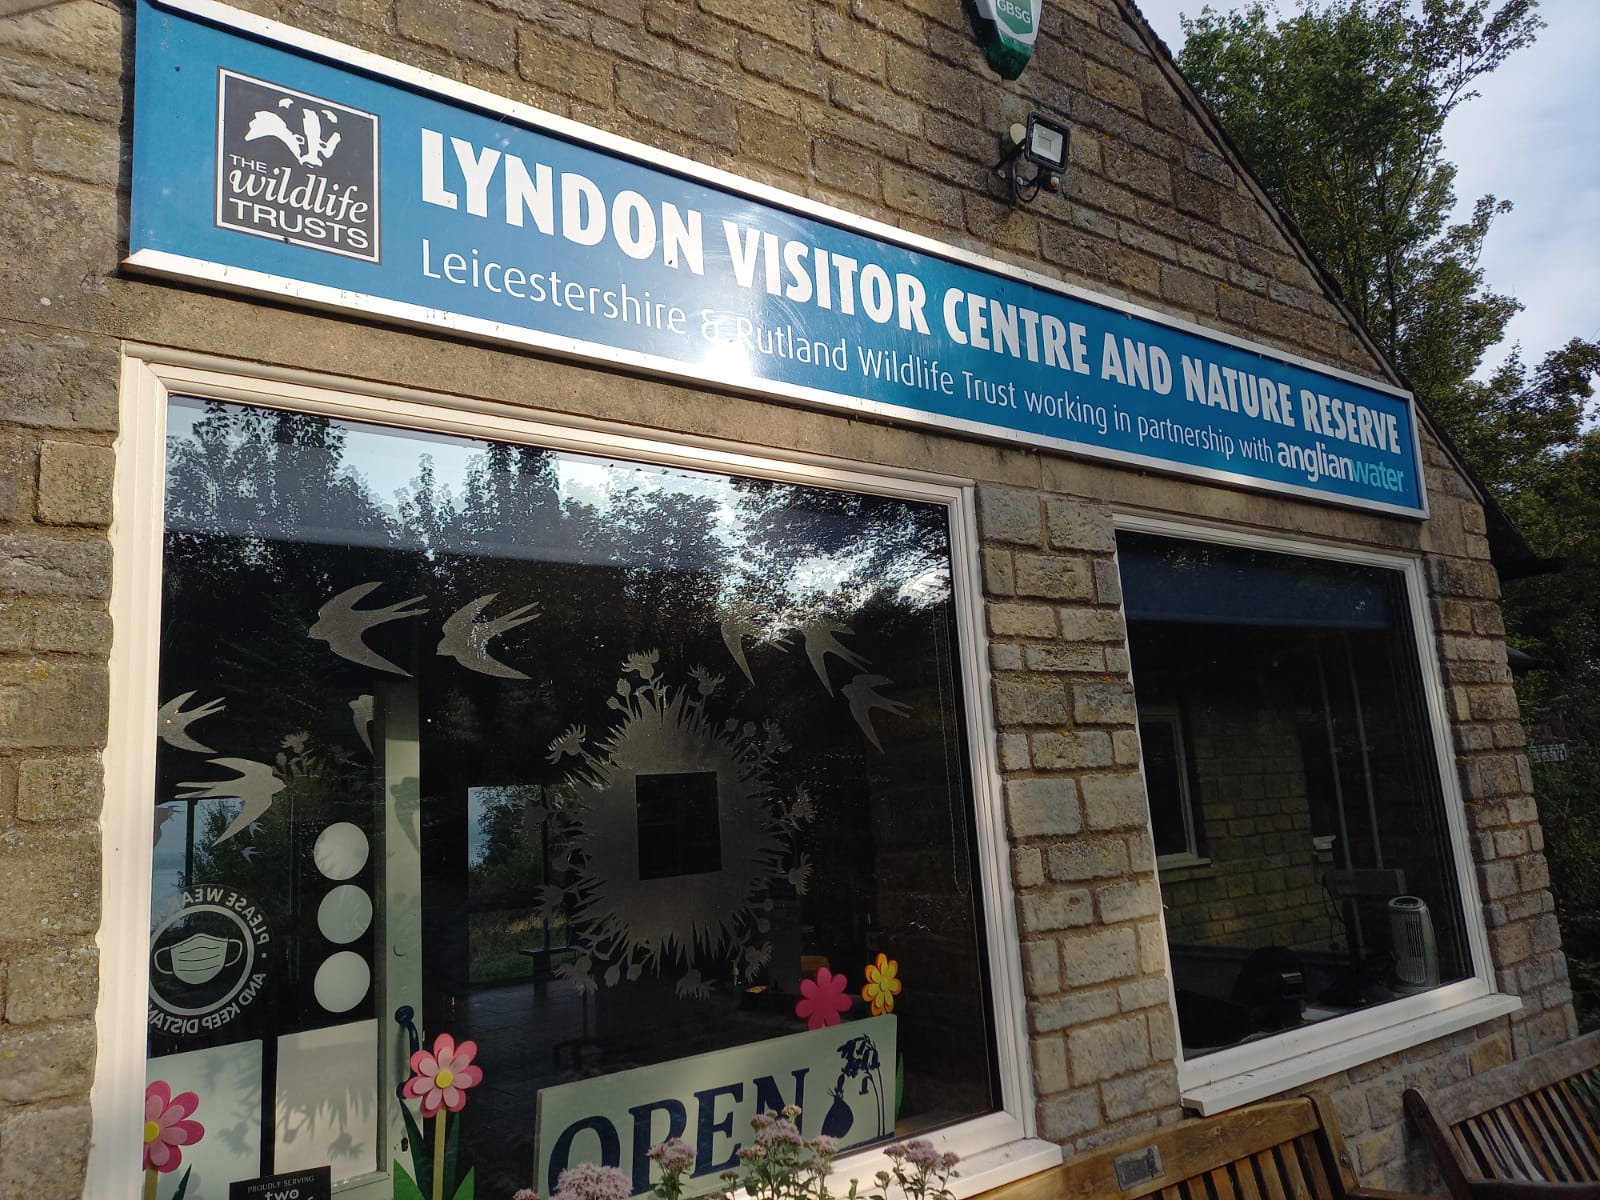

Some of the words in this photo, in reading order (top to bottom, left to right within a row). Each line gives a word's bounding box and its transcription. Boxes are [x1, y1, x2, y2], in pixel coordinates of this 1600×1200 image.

[997, 0, 1031, 23] GBSG
[229, 154, 267, 174] THE
[229, 166, 368, 223] wildlife
[229, 197, 369, 249] TRUSTS
[421, 127, 705, 276] LYNDON
[722, 219, 931, 336] VISITOR
[943, 287, 1090, 376] CENTRE
[1101, 332, 1173, 395] AND
[1181, 354, 1295, 427] NATURE
[1300, 389, 1401, 455] RESERVE
[422, 238, 687, 335] Leicestershire
[701, 308, 721, 343] &
[735, 316, 848, 371] Rutland
[857, 345, 954, 395] Wildlife
[961, 370, 1017, 409] Trust
[1023, 390, 1108, 435] working
[1113, 404, 1131, 433] in
[1137, 416, 1234, 461] partnership
[1238, 436, 1273, 464] with
[548, 1067, 810, 1200] OPEN
[247, 1181, 281, 1193] PROUDLY
[283, 1175, 315, 1188] SERVING
